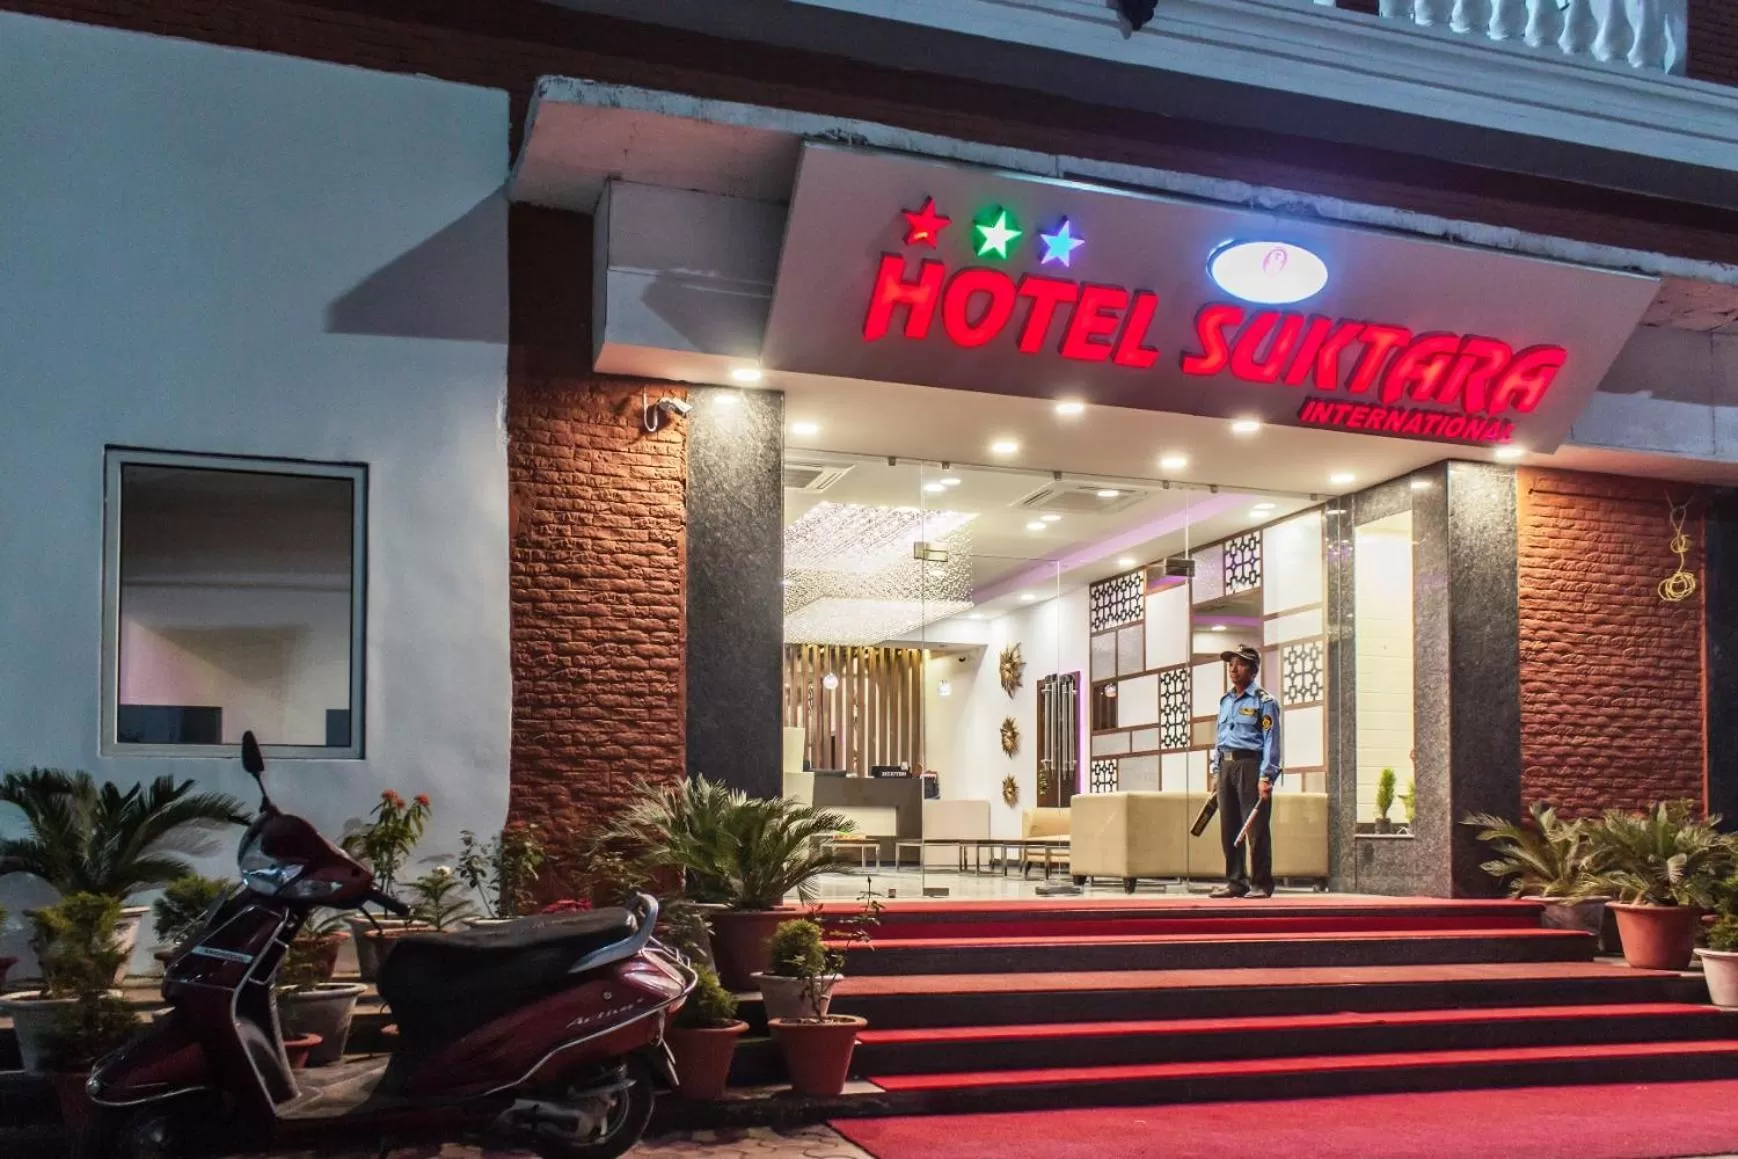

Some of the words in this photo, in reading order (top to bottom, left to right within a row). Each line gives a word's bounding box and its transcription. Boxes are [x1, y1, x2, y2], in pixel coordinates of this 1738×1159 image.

[861, 251, 1161, 369] HOTEL
[1180, 302, 1568, 414] SUKTARA
[1300, 398, 1516, 444] INTERNATIONAL
